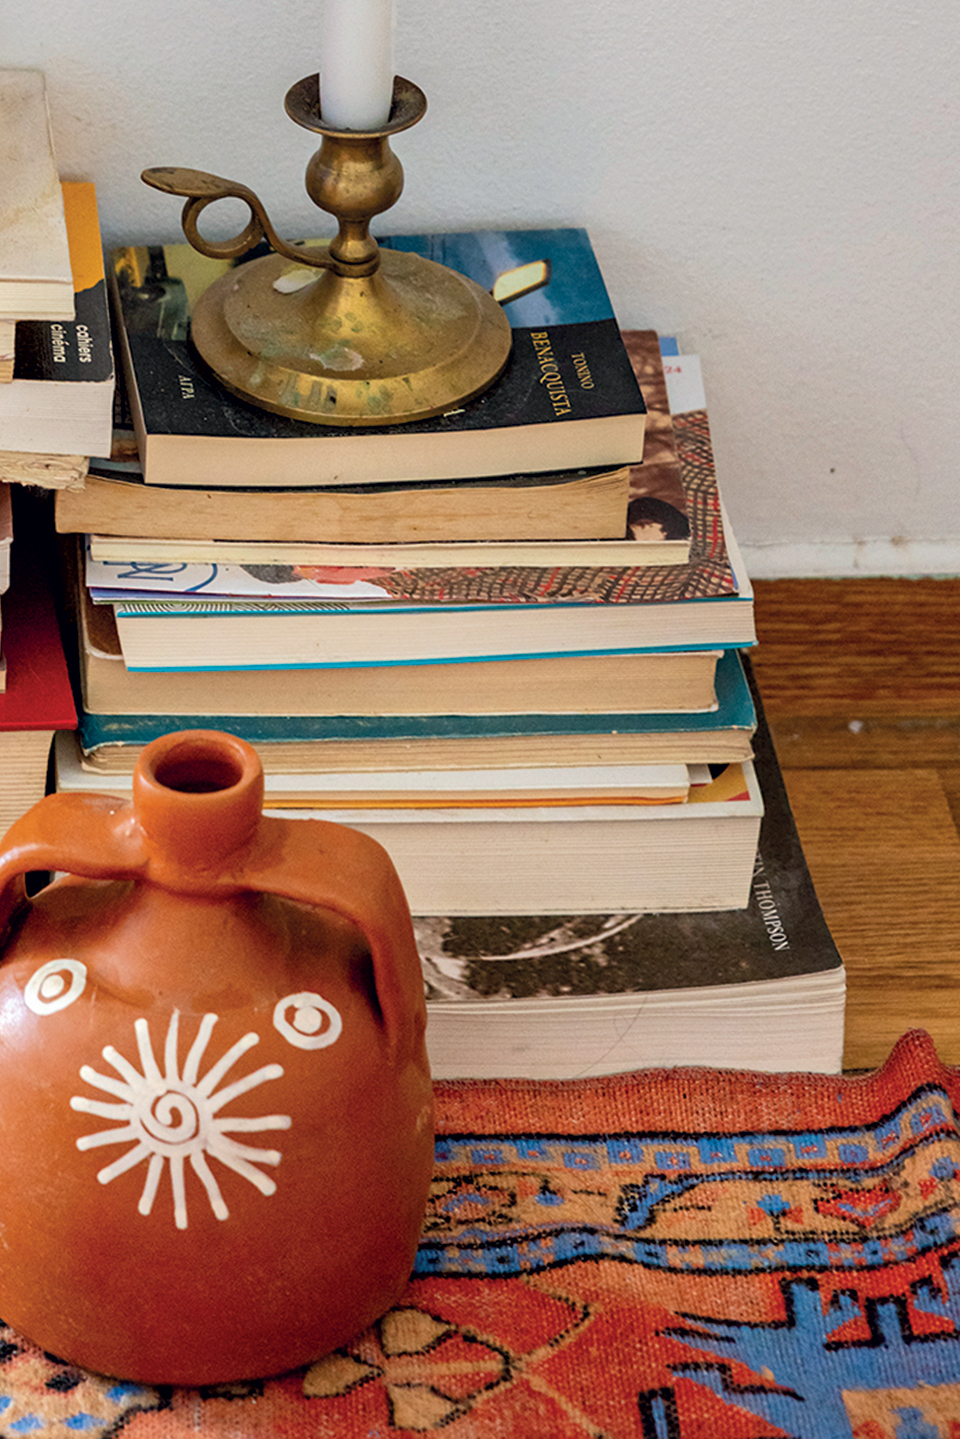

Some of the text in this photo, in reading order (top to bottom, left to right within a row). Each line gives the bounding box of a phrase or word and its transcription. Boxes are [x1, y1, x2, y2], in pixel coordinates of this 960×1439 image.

[50, 323, 70, 363] cinéma
[75, 324, 94, 363] cahiers
[530, 331, 572, 416] BENACQUISTA
[571, 352, 595, 390] TONINO
[753, 880, 790, 951] THOMPSON
